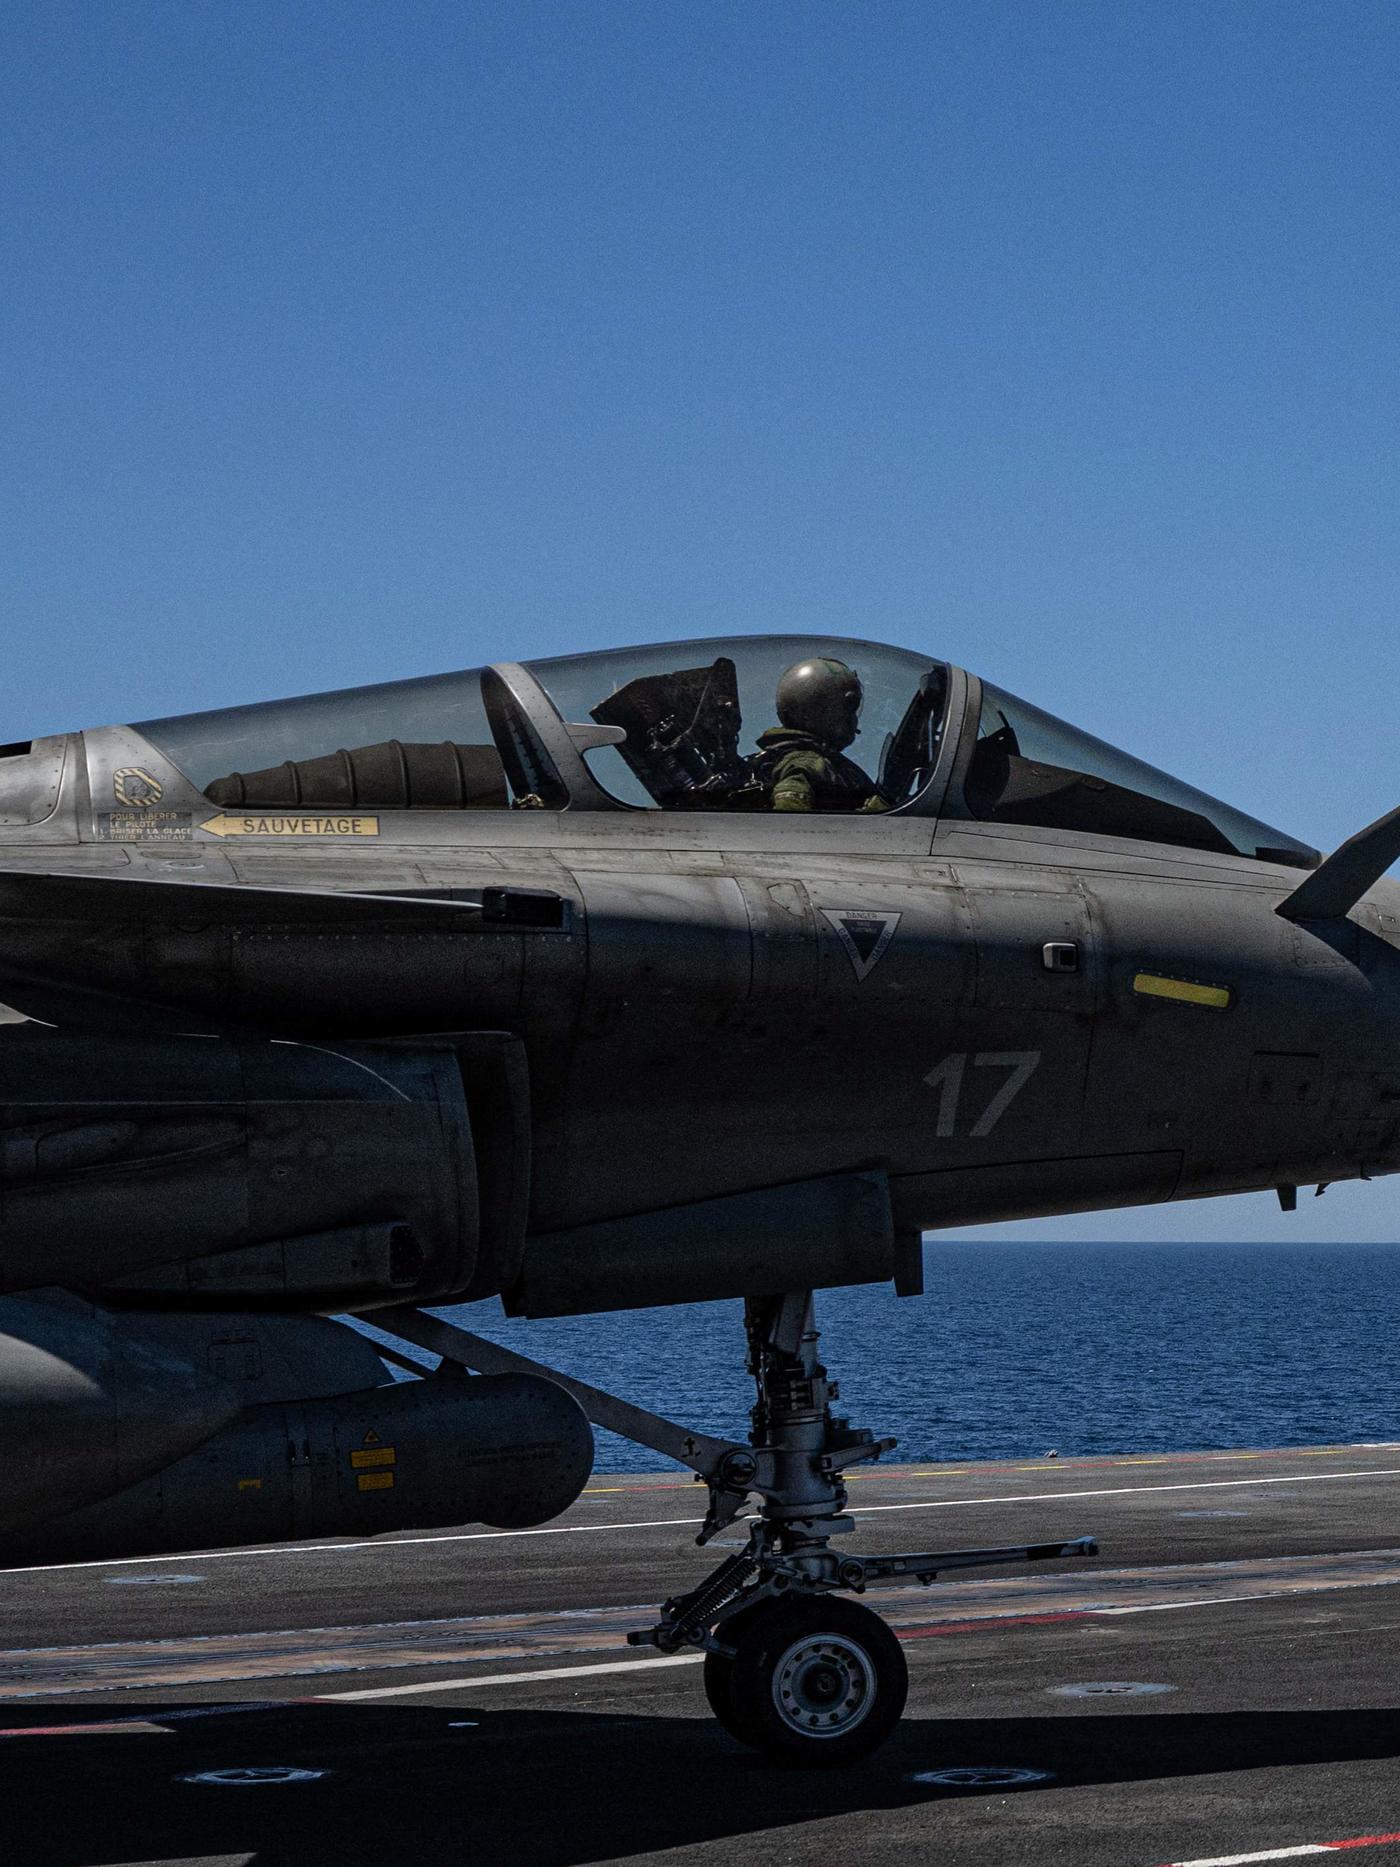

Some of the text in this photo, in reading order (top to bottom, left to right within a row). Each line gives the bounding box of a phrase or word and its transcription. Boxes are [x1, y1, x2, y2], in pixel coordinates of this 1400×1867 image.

[110, 812, 135, 821] POUR
[110, 820, 156, 828] LE PILOTE
[243, 818, 363, 834] SAUVETAGE
[110, 827, 143, 835] BRISER
[147, 827, 159, 835] LA
[163, 827, 193, 835] GLACE
[922, 1050, 1042, 1137] 17
